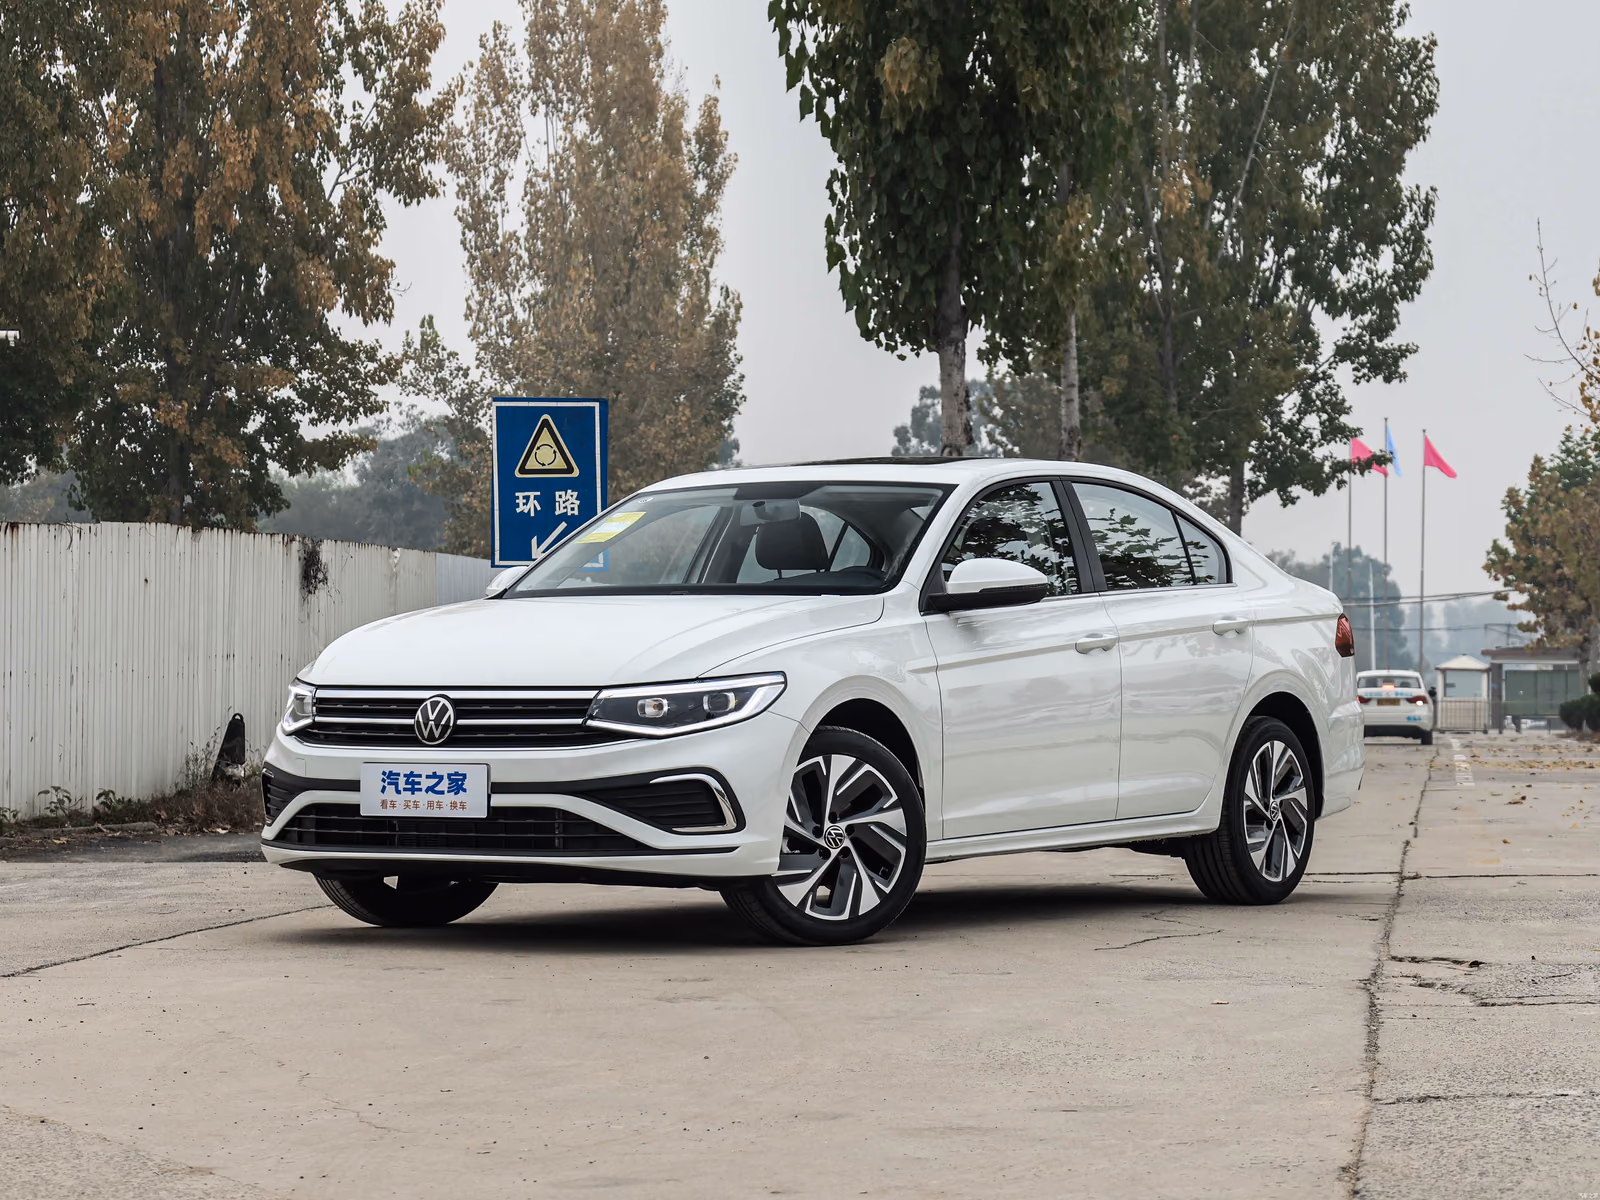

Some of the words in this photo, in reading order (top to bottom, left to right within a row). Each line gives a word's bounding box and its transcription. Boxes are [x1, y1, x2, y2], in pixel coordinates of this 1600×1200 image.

[515, 489, 581, 517] 环路
[380, 770, 468, 796] 汽车之家
